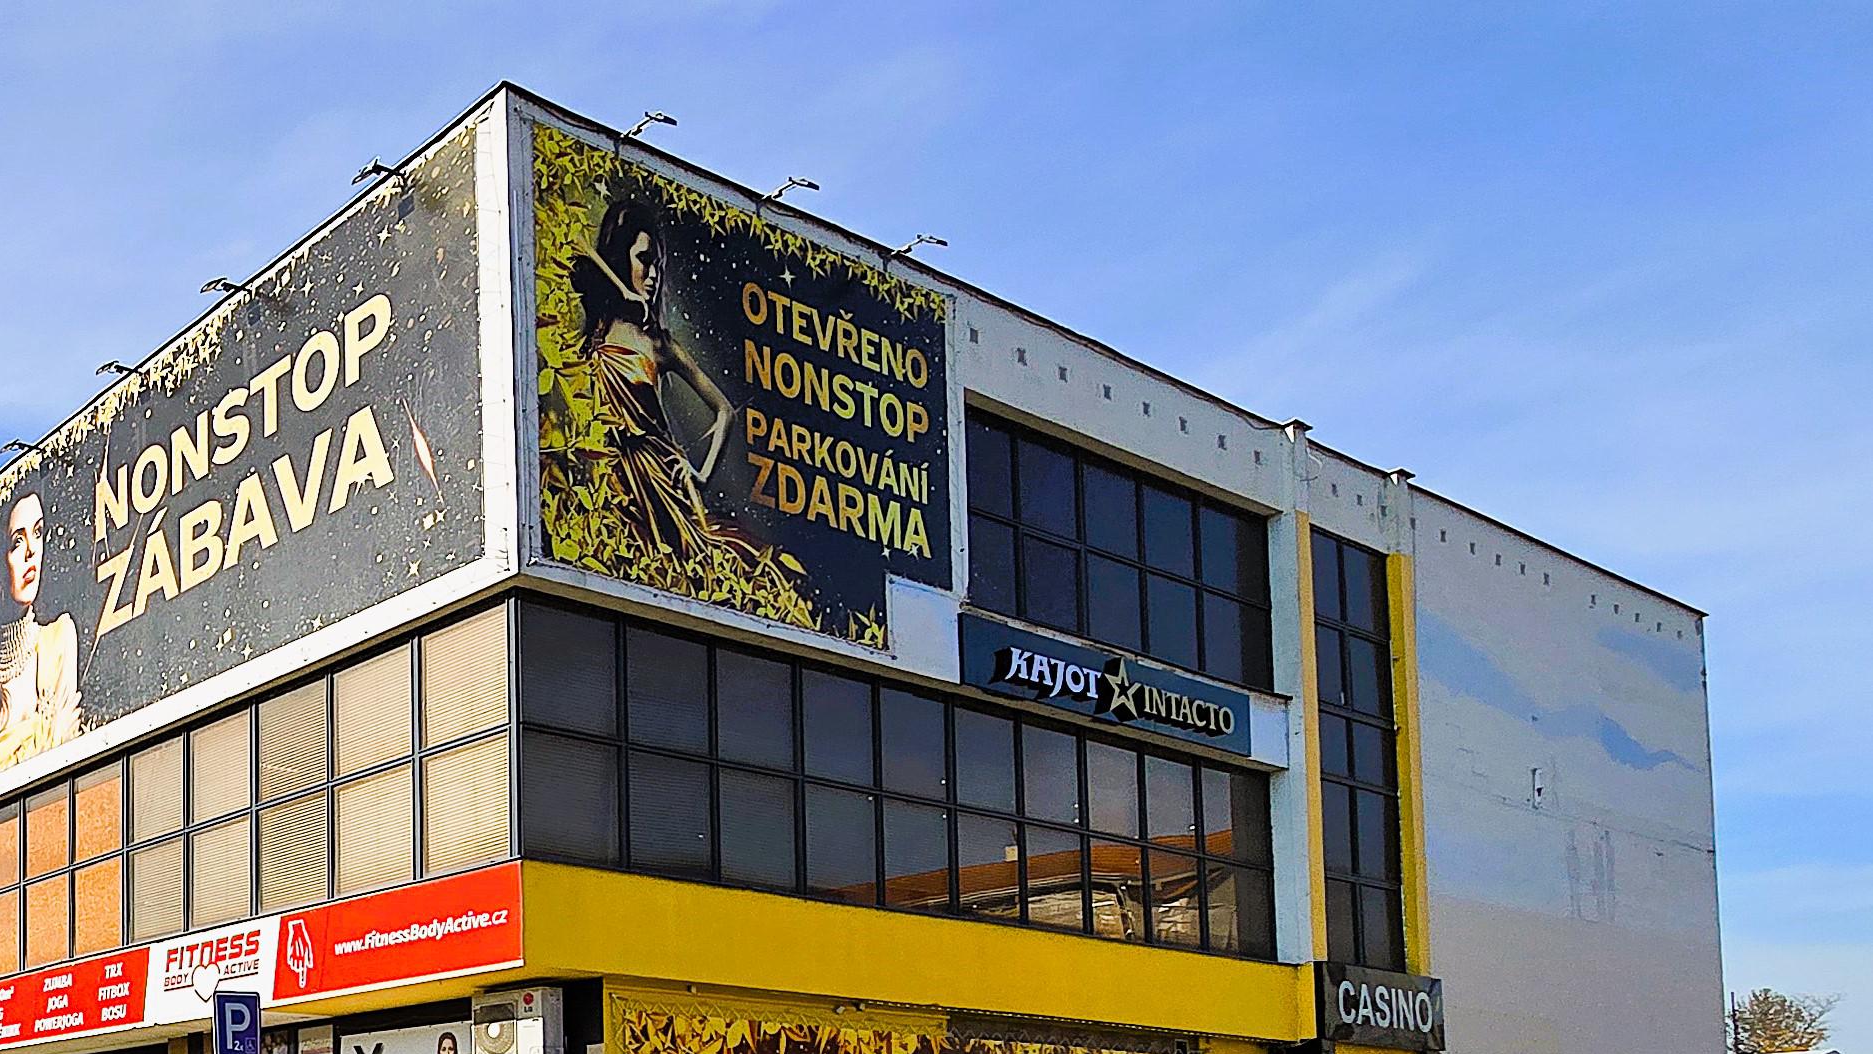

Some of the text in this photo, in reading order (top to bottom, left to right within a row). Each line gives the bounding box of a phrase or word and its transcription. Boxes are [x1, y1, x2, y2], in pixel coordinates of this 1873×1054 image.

[742, 282, 928, 389] OTEVŘENO
[744, 339, 929, 443] NONSTOP
[94, 293, 393, 544] NONSTOP
[746, 408, 929, 505] PARKOVÁNÍ
[94, 405, 395, 640] ZÁBAVA
[747, 452, 932, 559] ZDARMA
[1004, 647, 1235, 734] KAJOT INTACTO
[165, 930, 261, 972] FITNESS
[334, 909, 509, 956] www.FitnessBodyActive.cz
[42, 973, 73, 992] ZUMBA
[98, 981, 130, 1001] FITBOX
[104, 962, 124, 980] TRX
[164, 959, 260, 987] BODY ACTIVE
[34, 1011, 84, 1032] POWERJOGA
[46, 994, 69, 1013] JOGA
[101, 1004, 127, 1022] BOSU
[225, 1002, 251, 1050] P
[1338, 980, 1433, 1033] CASINO
